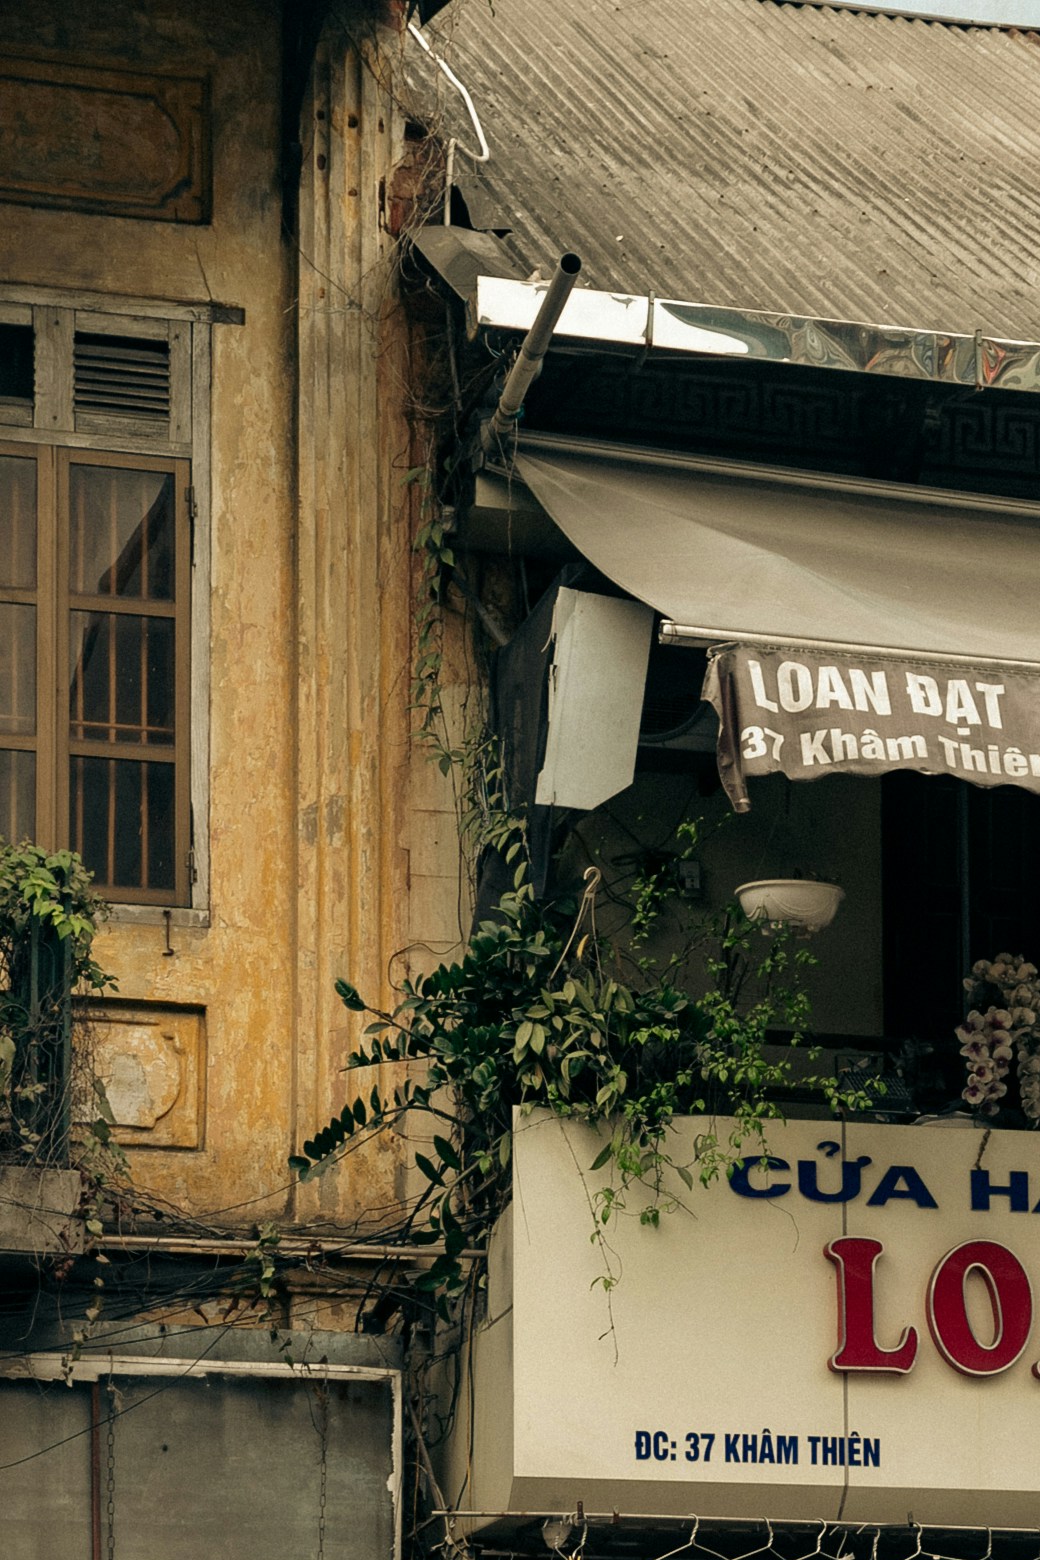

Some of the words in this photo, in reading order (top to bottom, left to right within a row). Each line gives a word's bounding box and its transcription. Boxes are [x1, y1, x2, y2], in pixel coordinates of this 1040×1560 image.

[748, 658, 889, 716] LOAN
[906, 671, 1005, 736] ĐẠT
[741, 725, 786, 761] 37
[803, 726, 928, 766] Khâm
[728, 1140, 940, 1210] CỬA
[633, 1430, 677, 1462] ĐC:
[684, 1432, 716, 1463] 37
[724, 1427, 799, 1465] KHÂM
[807, 1429, 881, 1468] THIÊN
